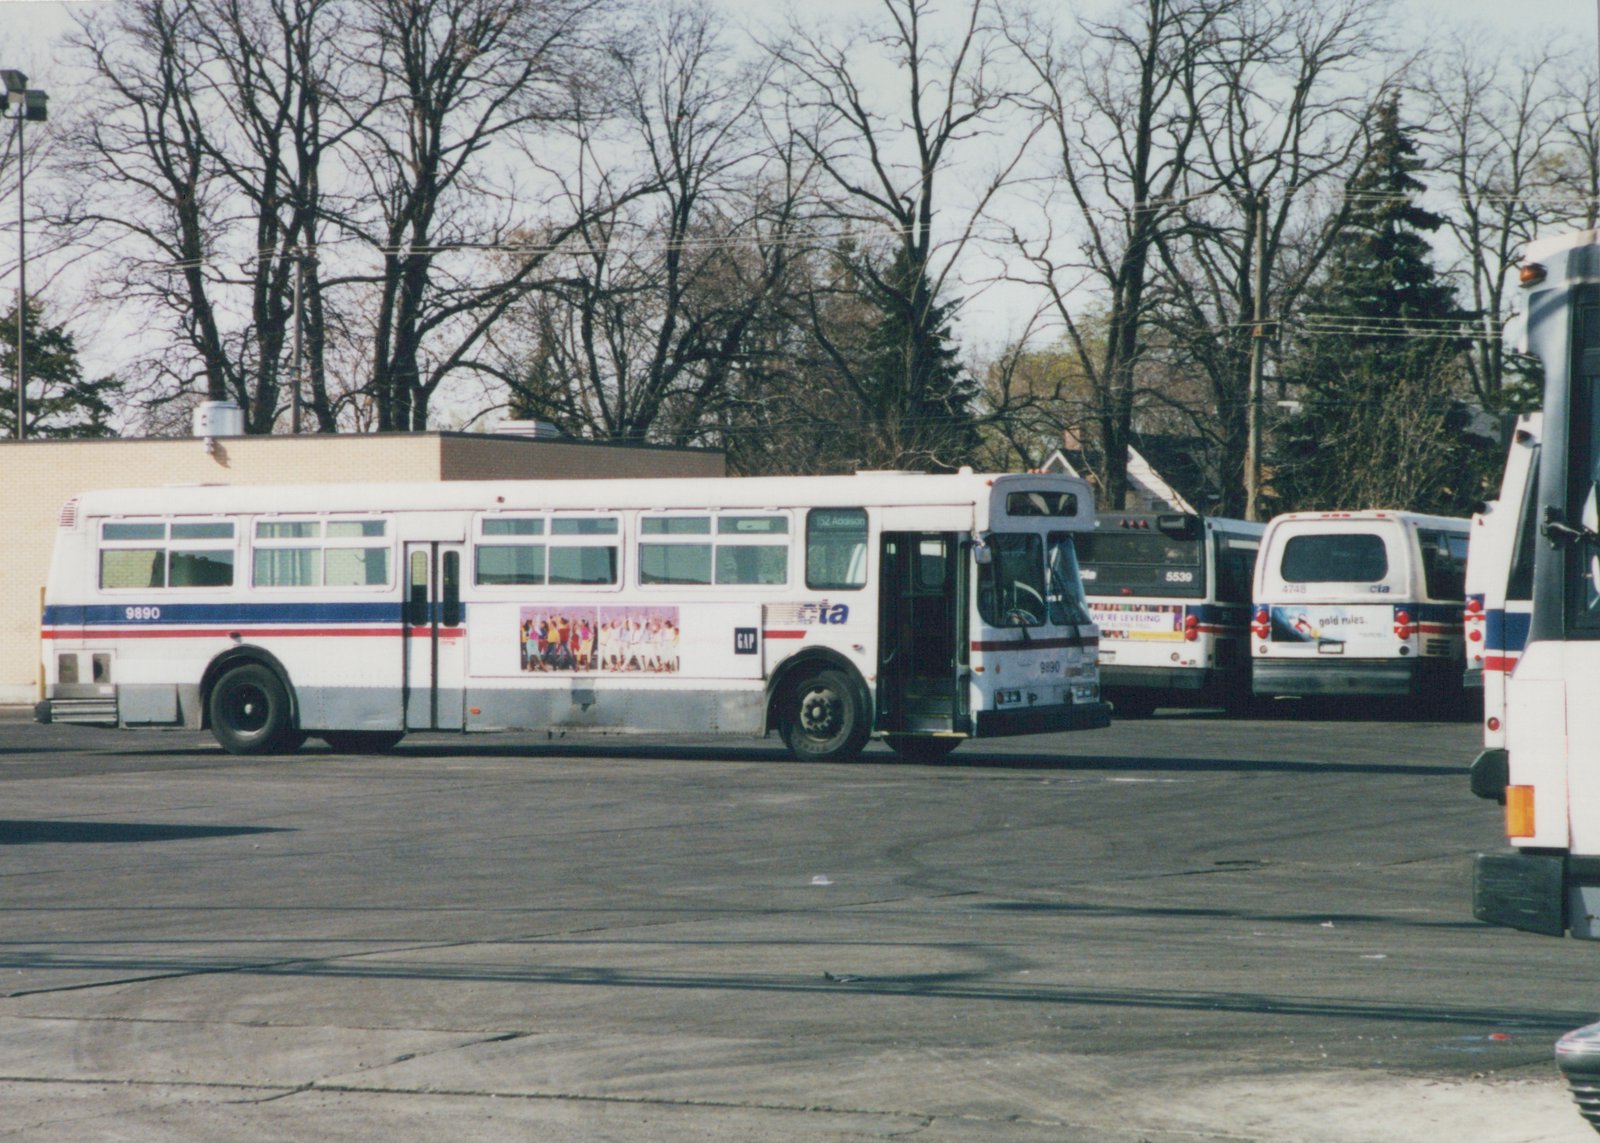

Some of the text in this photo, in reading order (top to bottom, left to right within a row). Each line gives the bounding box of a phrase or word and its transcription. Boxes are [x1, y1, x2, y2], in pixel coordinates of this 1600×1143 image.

[1165, 571, 1192, 582] 5539
[1369, 584, 1390, 593] cta
[126, 606, 160, 619] 9890
[798, 599, 849, 624] cta
[1121, 614, 1160, 623] LEVELING
[1319, 616, 1339, 628] gold
[737, 633, 754, 649] GAP
[1040, 660, 1060, 674] 9890
